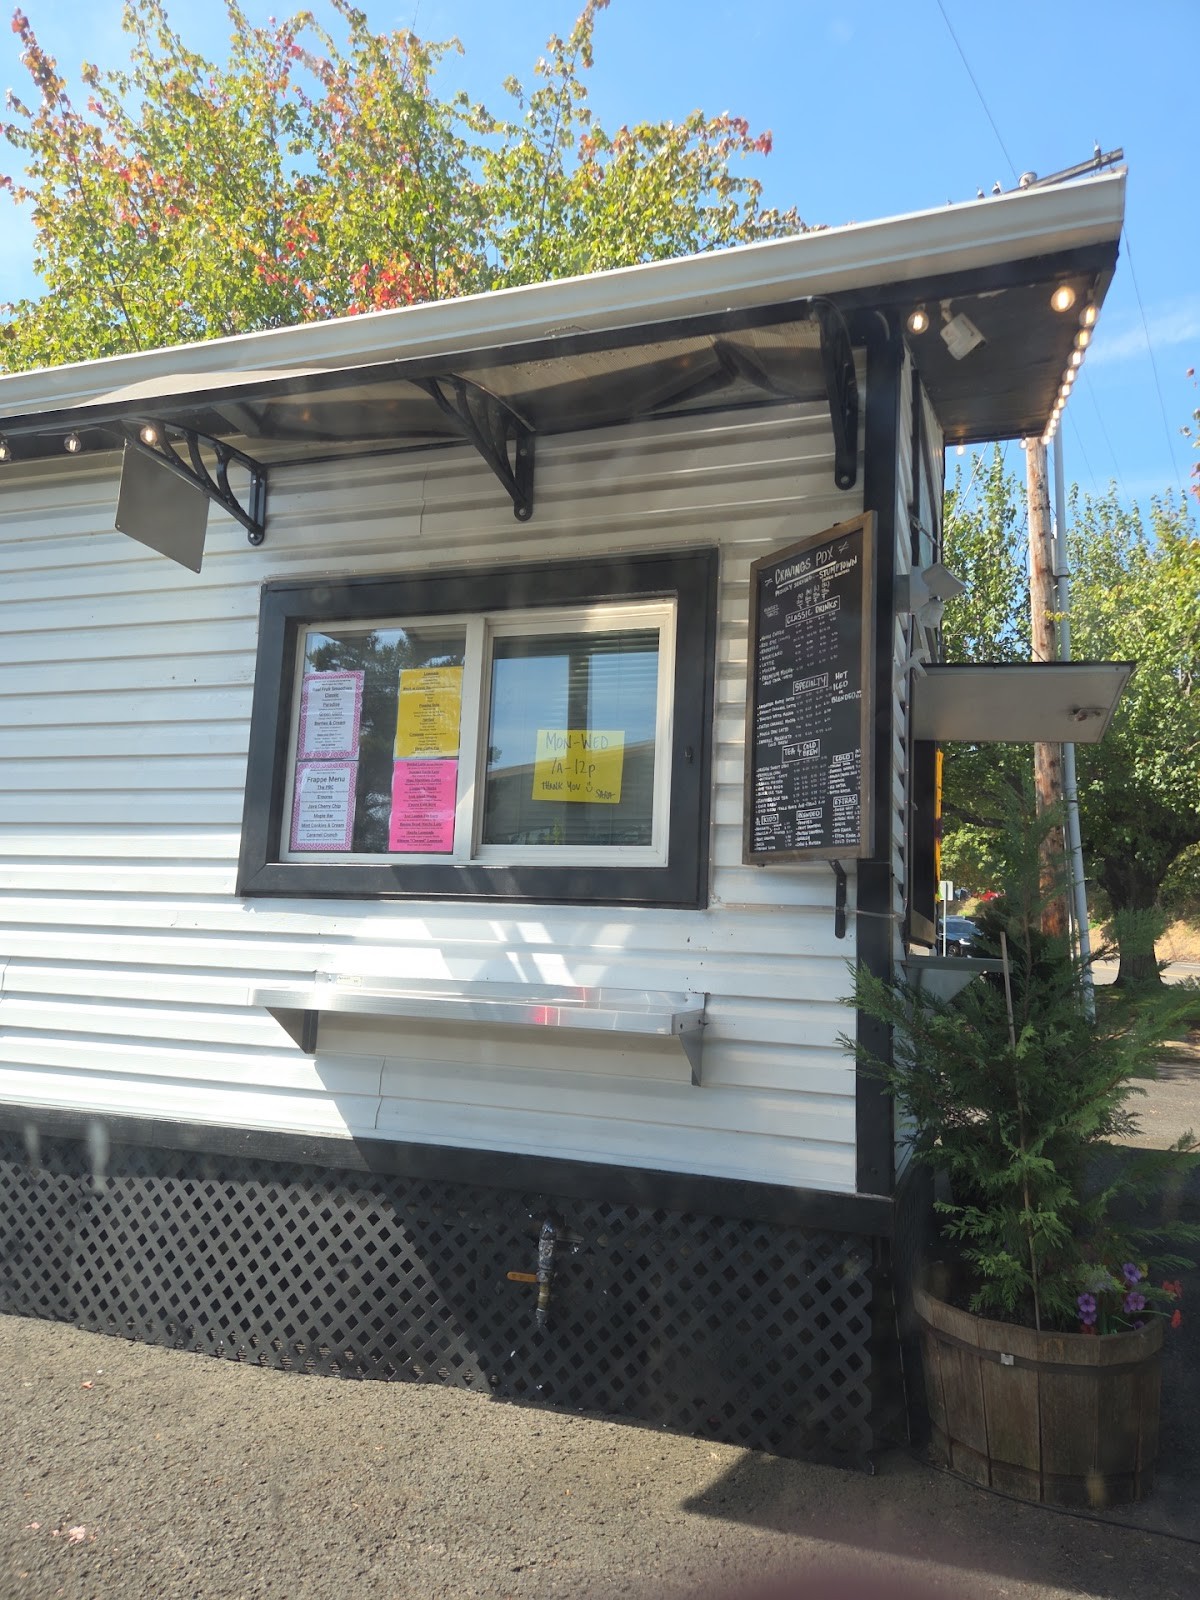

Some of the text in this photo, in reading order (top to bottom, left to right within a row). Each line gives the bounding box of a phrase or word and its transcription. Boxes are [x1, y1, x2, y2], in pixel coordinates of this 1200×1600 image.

[775, 546, 834, 585] CRAVINGS PDX
[819, 555, 858, 579] STUMPTOWN
[786, 610, 813, 624] CLASSIC
[815, 600, 837, 614] DRINKS
[835, 670, 848, 680] HOT
[795, 676, 826, 692] SPECIALTY
[546, 732, 609, 750] MON-WED
[784, 748, 796, 756] TEA
[803, 742, 816, 750] COLD
[763, 815, 777, 824] KIDS
